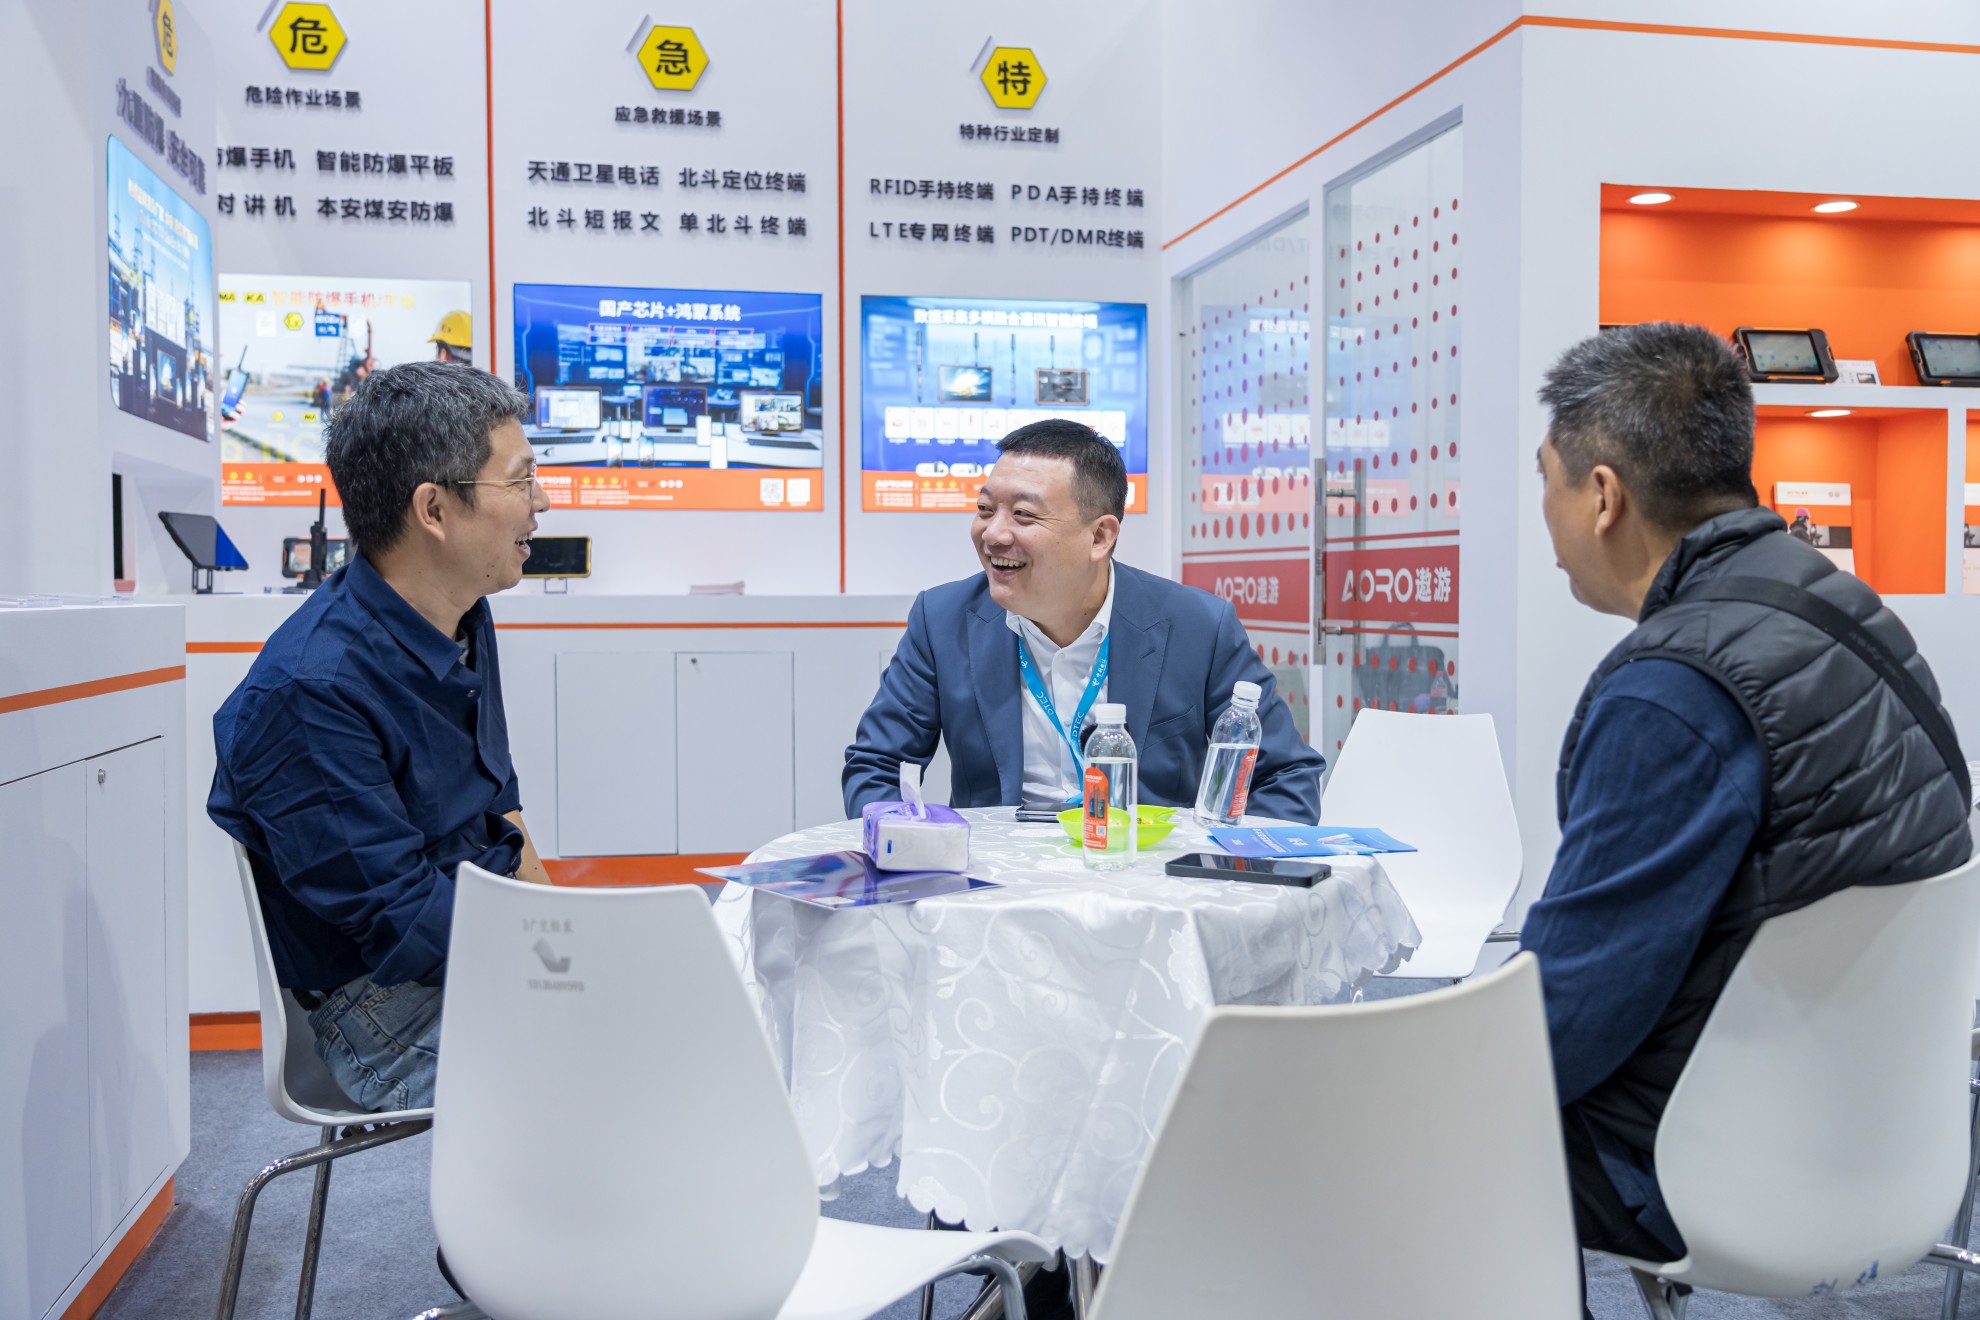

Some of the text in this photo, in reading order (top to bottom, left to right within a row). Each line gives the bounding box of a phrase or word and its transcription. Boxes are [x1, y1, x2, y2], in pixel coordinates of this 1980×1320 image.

[290, 17, 327, 54] 危
[656, 40, 691, 75] 急
[998, 61, 1031, 95] 特
[246, 86, 360, 108] 危险作业场景
[616, 107, 720, 127] 应急救援场景
[960, 124, 1059, 143] 特种行业定制
[217, 147, 453, 176] 爆手机 智能防爆平板
[528, 161, 806, 193] 天通卫星电话 北斗定位终端
[870, 179, 1144, 207] RFID手持终端 PDA手持终端
[317, 198, 454, 222] 本安煤安防爆
[528, 207, 806, 236] 北斗短报文 单北斗终端
[870, 222, 1144, 248] LTE专网终端 PDT/DMR终端
[599, 300, 742, 322] 国产芯片+鸿蒙系统
[1214, 576, 1279, 605] AORO遨游
[1341, 567, 1452, 603] AORO遨游
[1036, 691, 1054, 716] DTEC
[1072, 711, 1085, 738] DTEC
